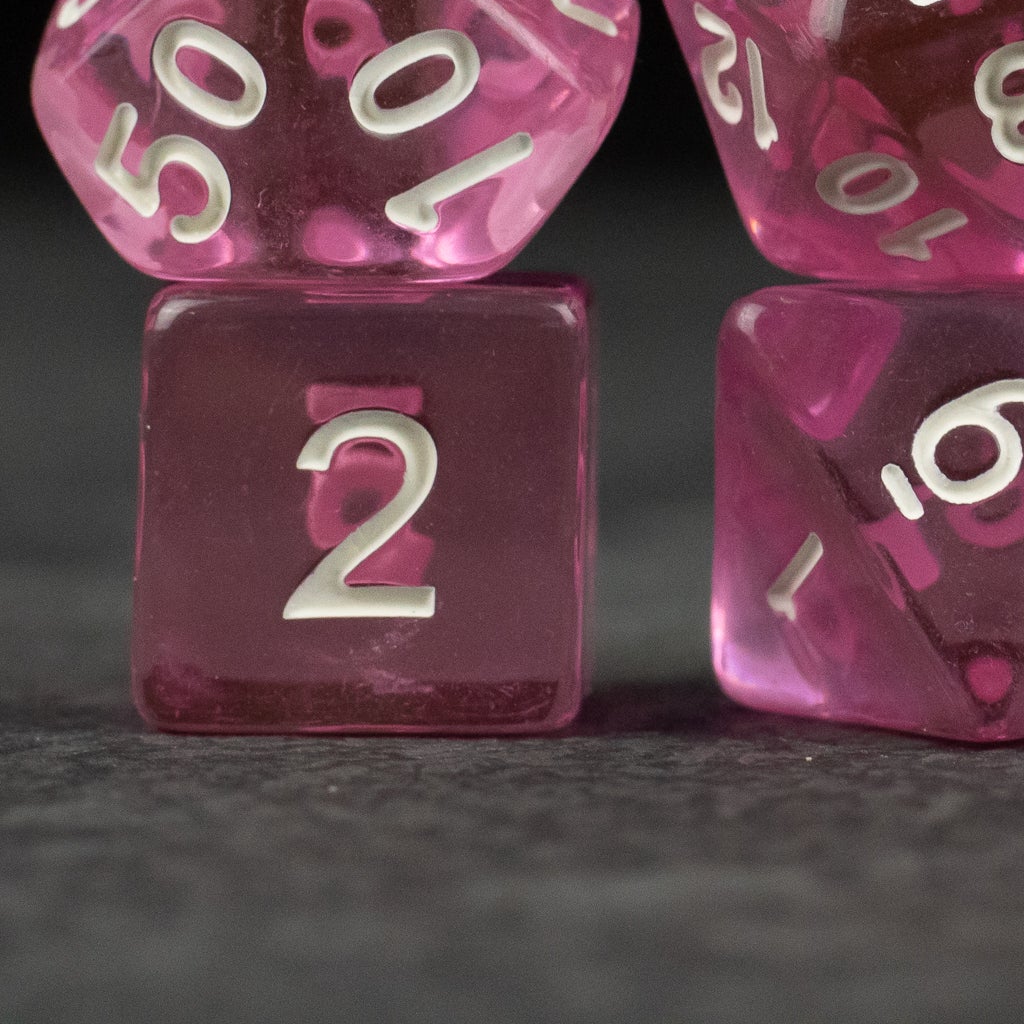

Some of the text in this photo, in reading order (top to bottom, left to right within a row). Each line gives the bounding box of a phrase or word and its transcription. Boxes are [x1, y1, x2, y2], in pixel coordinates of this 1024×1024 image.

[94, 19, 267, 244] 50
[349, 28, 534, 233] 10
[815, 152, 968, 261] 10
[283, 409, 438, 619] 2
